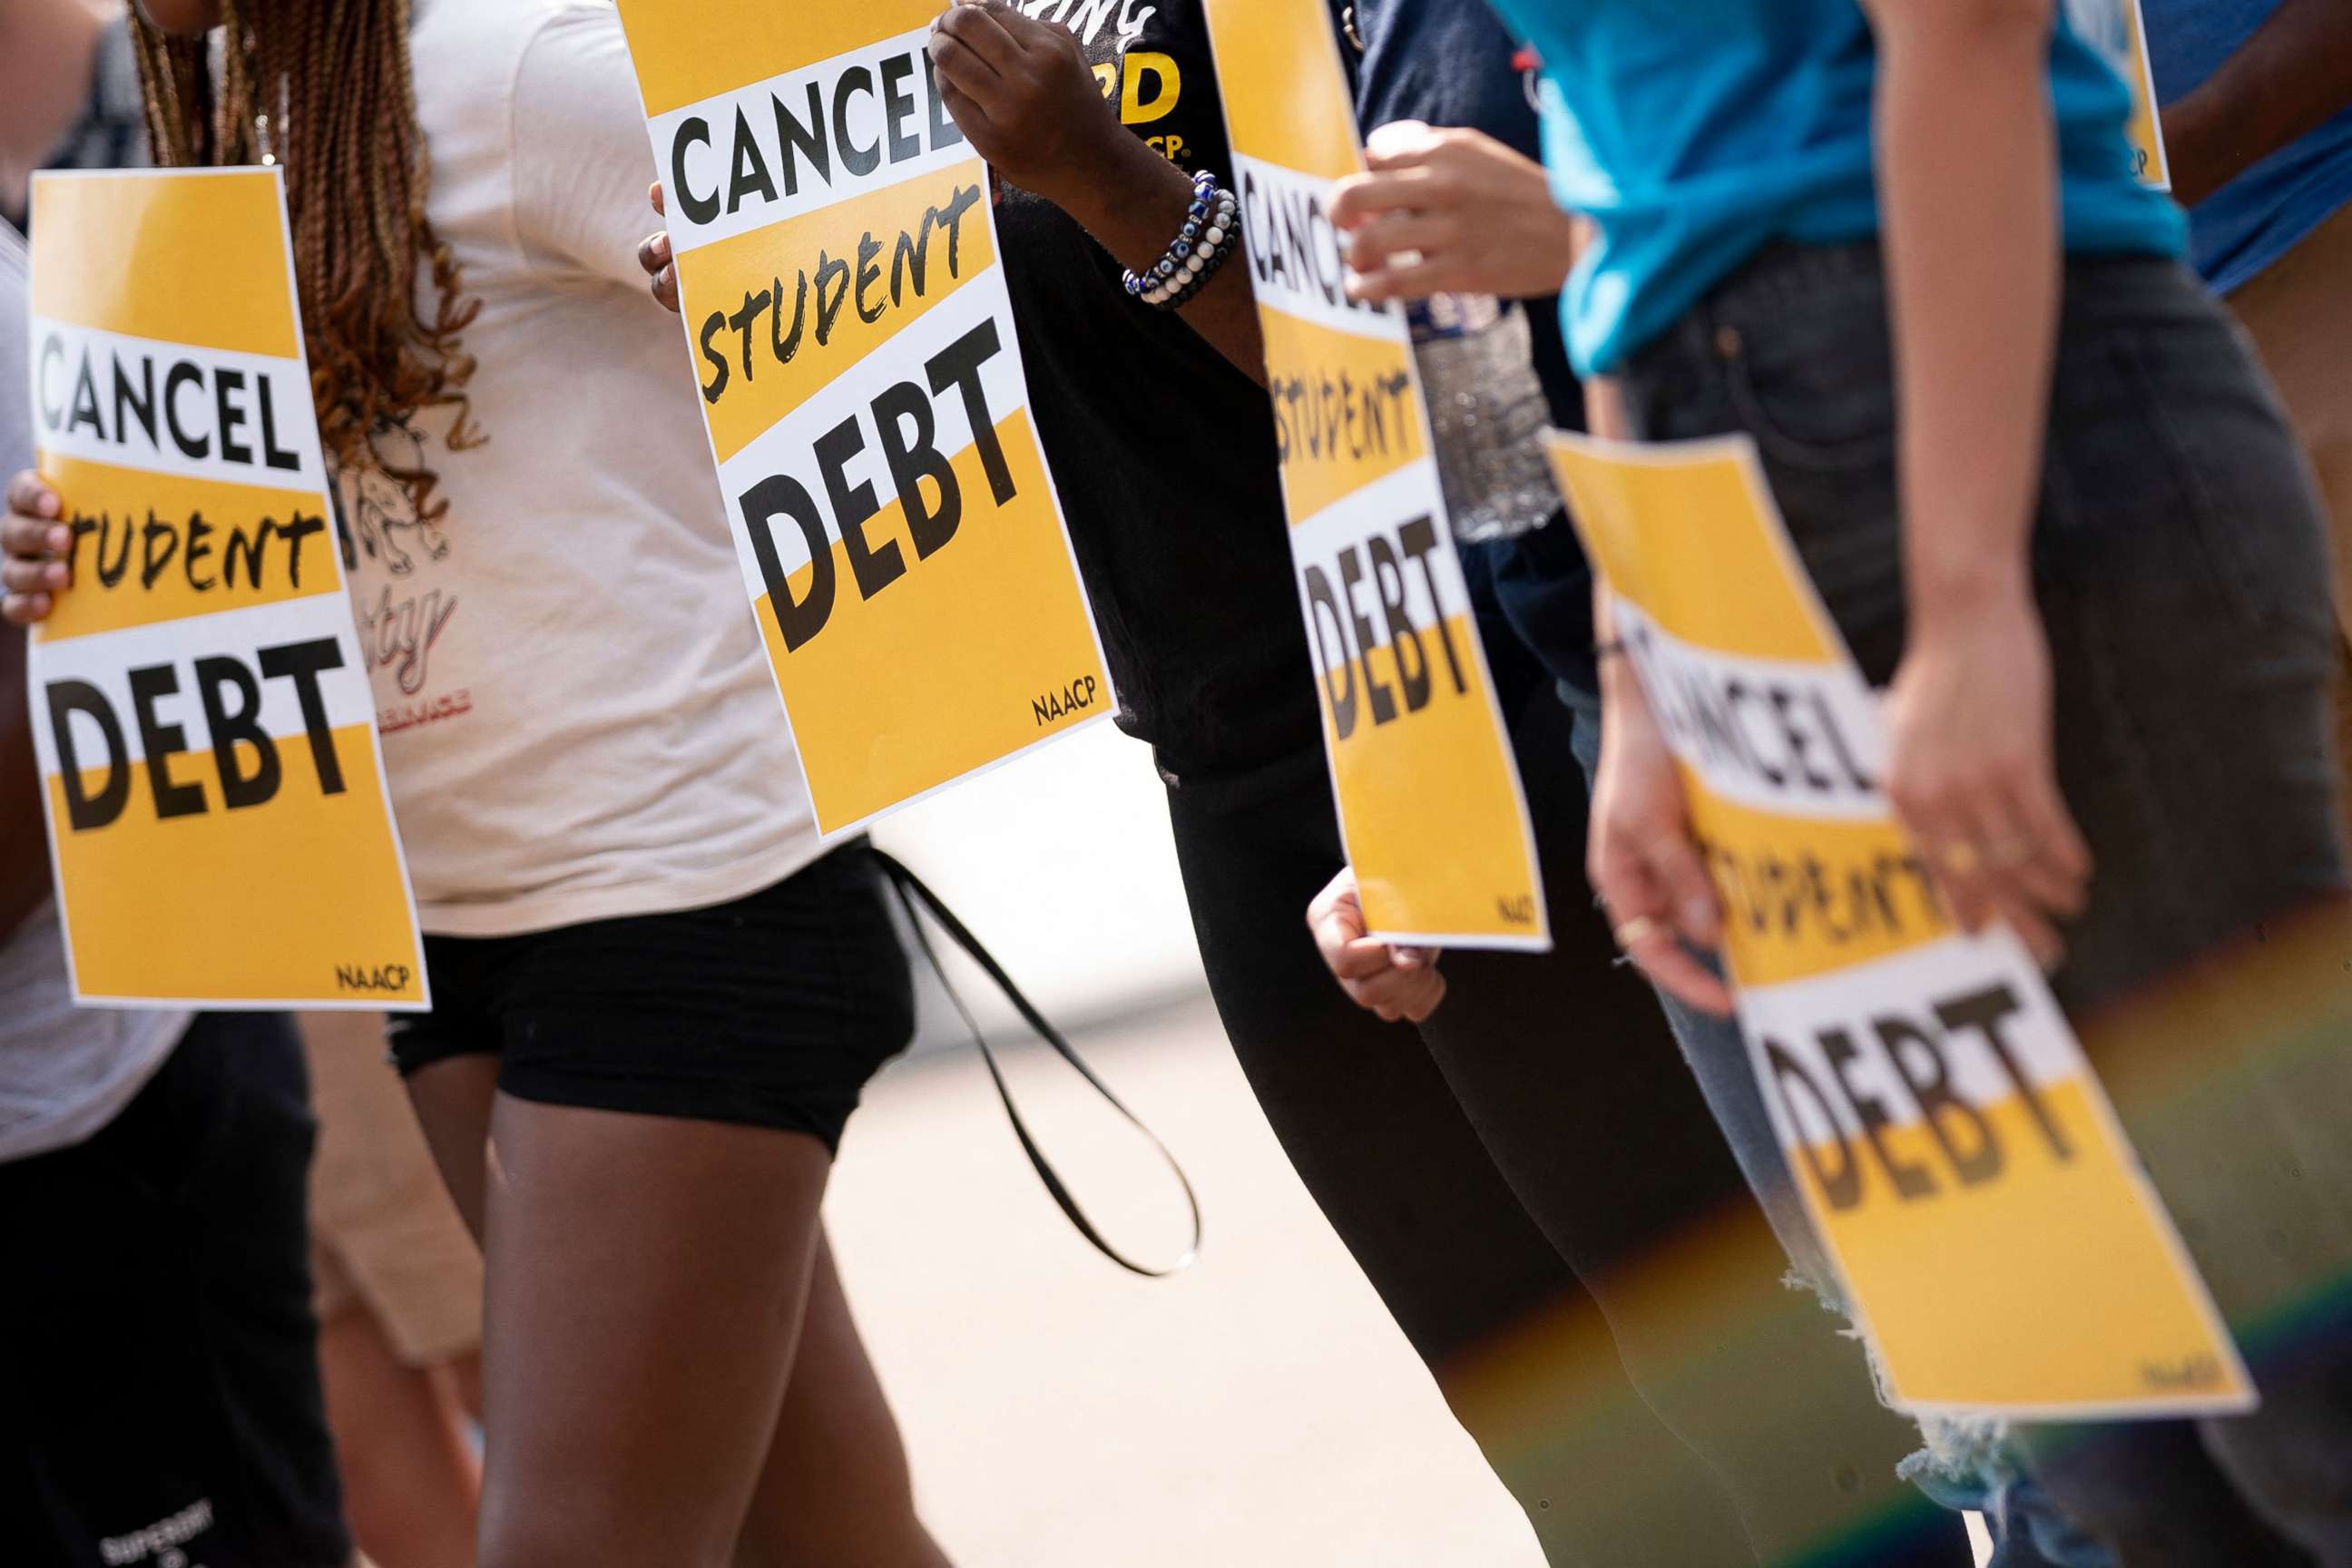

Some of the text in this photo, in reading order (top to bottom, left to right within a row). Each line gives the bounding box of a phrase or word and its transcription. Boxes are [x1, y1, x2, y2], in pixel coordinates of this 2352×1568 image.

[698, 183, 981, 404] STUDENT
[1244, 170, 1388, 315] CANC
[38, 330, 301, 471] CANCEL
[1272, 368, 1410, 464] STUDENT
[69, 506, 325, 592] TUDENT
[739, 316, 1017, 653] DEBT
[1303, 513, 1468, 742] DEBT
[45, 636, 347, 833] DEBT
[1031, 675, 1095, 726] NAACP
[336, 963, 410, 993] NAACP
[1762, 978, 2078, 1214] DEBT
